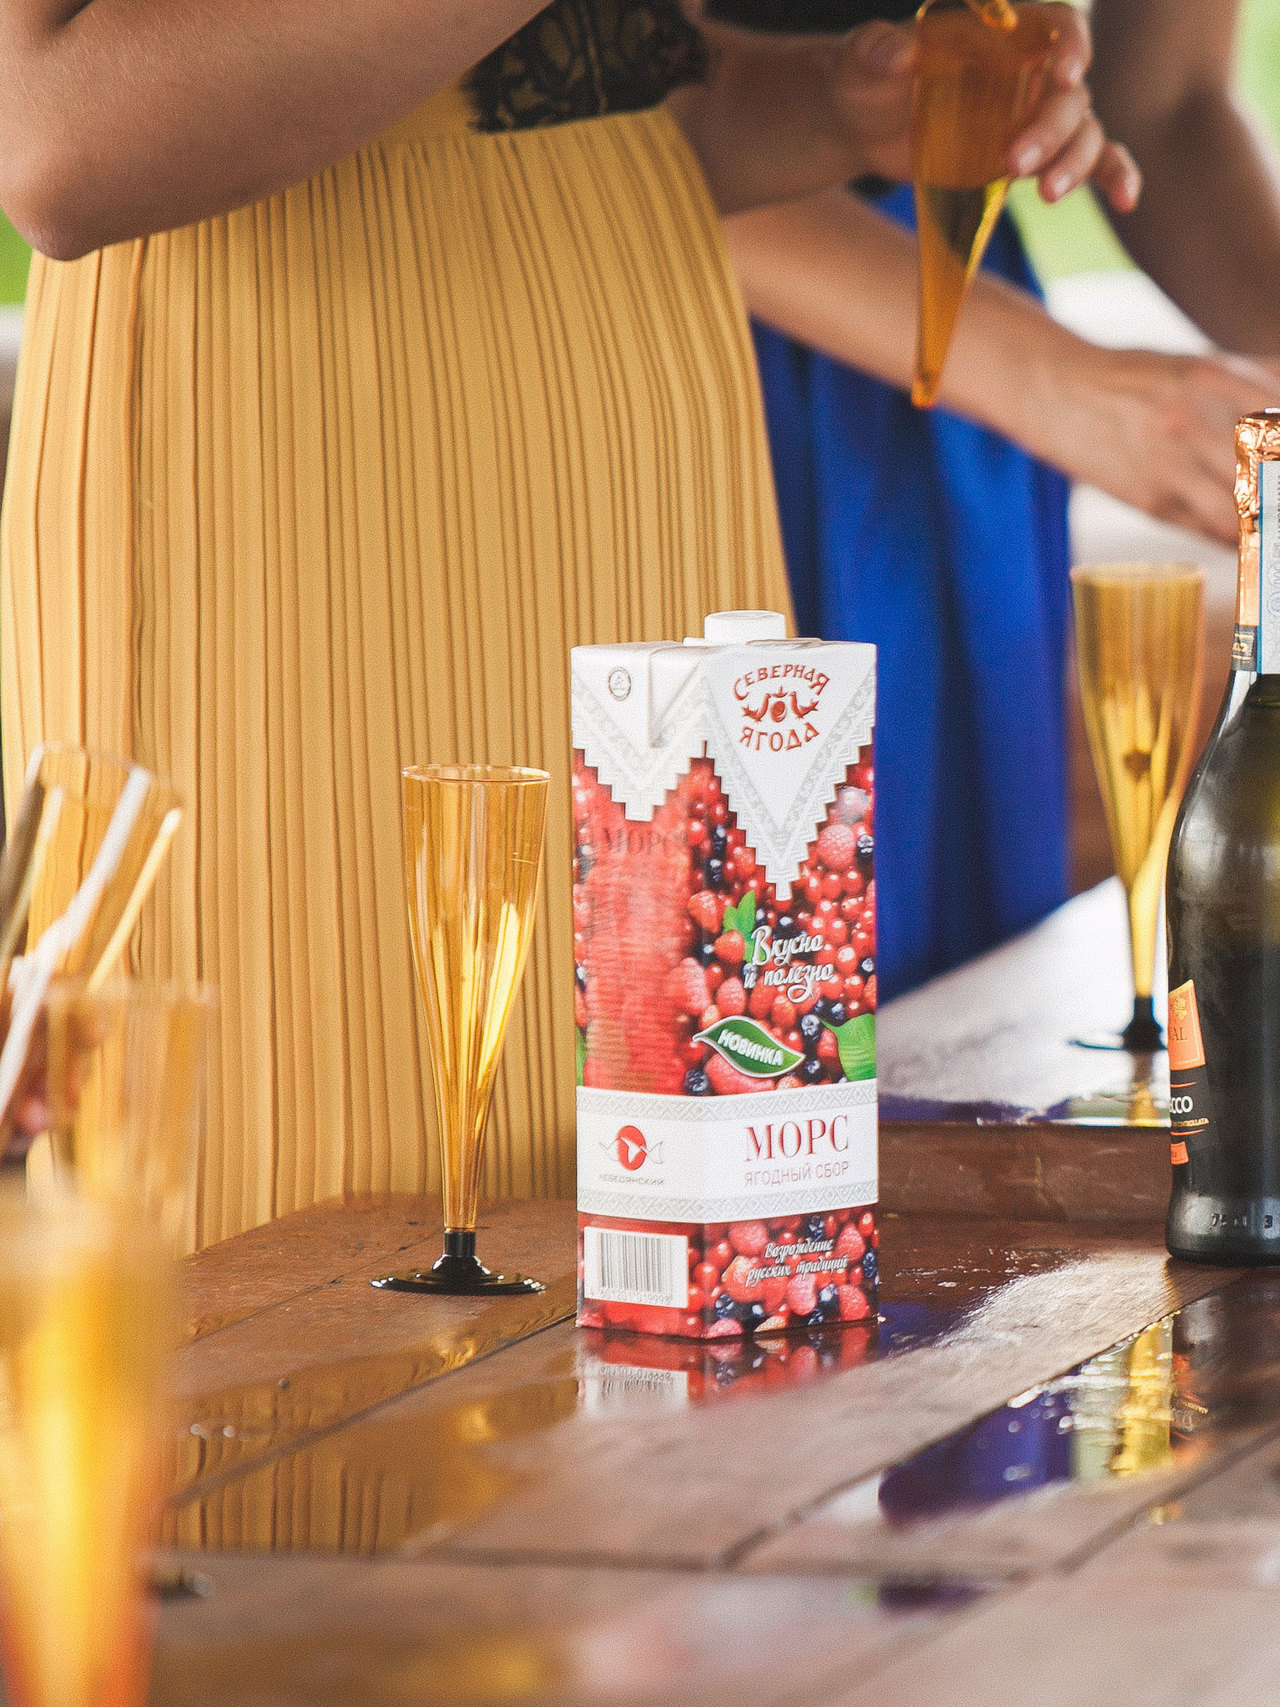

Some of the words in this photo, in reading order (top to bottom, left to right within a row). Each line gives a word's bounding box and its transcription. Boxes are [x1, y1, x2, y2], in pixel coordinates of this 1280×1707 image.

[733, 664, 830, 701] СЕВЕРНАЯ
[739, 721, 820, 752] ЯГОДА
[750, 925, 824, 967] Вкусно
[743, 971, 757, 989] и
[763, 963, 834, 1004] полезно
[716, 1029, 784, 1067] НОВИНКА
[744, 1114, 850, 1162] МОРС
[744, 1162, 811, 1187] ЯГОДНЫЙ
[815, 1160, 849, 1179] СБОР
[764, 1237, 834, 1264] Возрождение
[745, 1264, 792, 1288] русских
[796, 1254, 849, 1280] традиций
